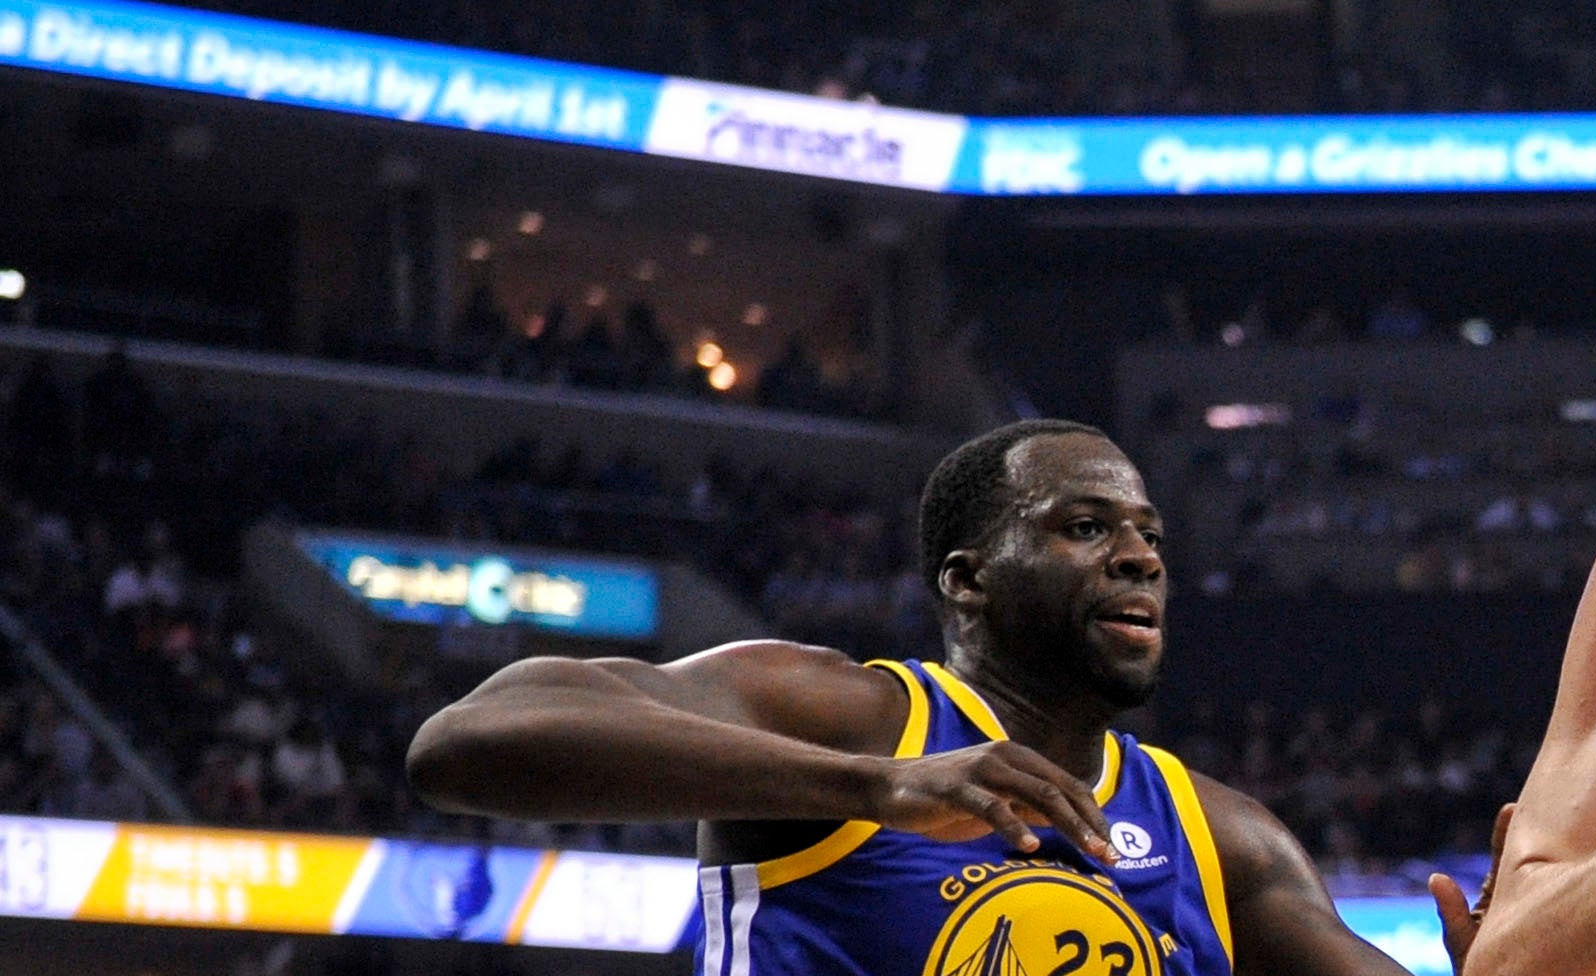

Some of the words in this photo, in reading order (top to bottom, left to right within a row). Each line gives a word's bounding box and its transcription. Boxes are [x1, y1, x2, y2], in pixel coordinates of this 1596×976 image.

[29, 8, 183, 79] Direct
[187, 31, 372, 105] Deposit
[375, 58, 439, 121] by
[438, 68, 555, 129] April
[557, 84, 627, 139] 1st
[1139, 135, 1270, 192] Open
[1310, 133, 1508, 183] Grizzlies
